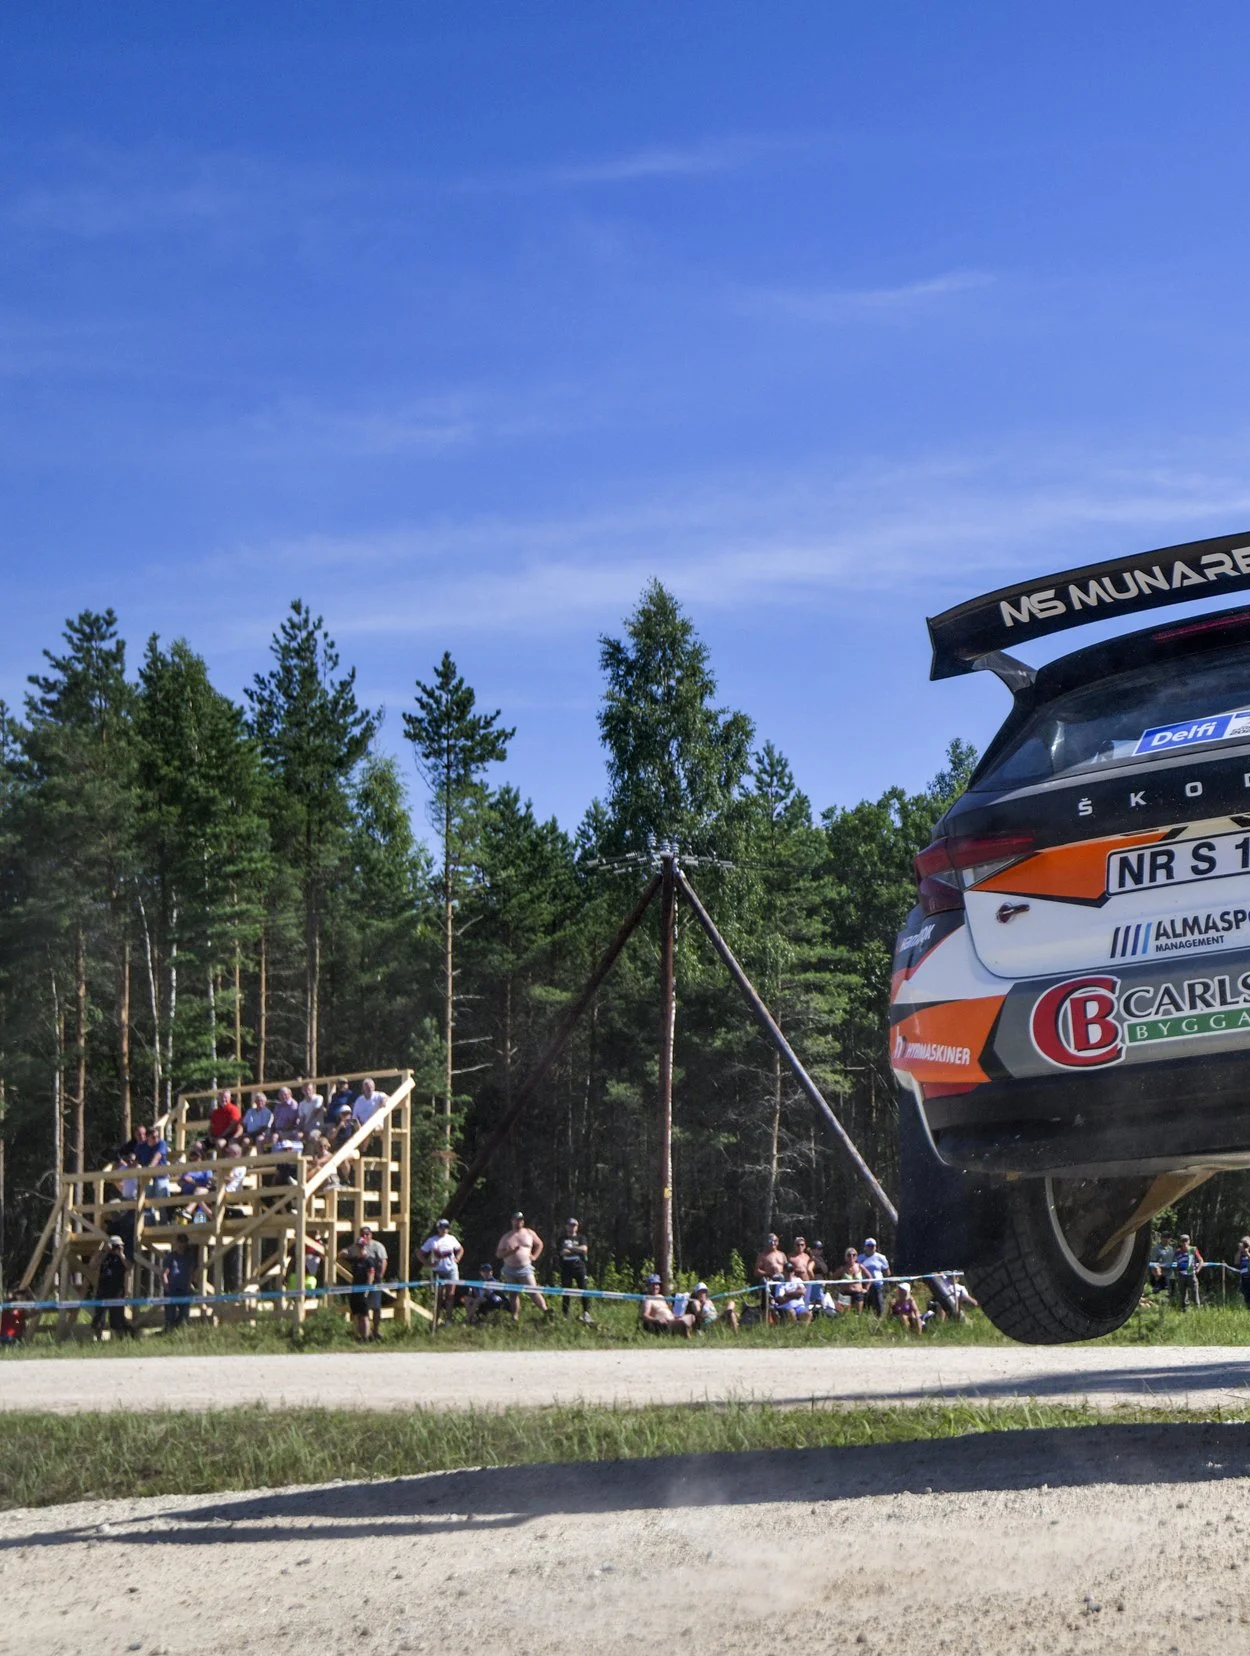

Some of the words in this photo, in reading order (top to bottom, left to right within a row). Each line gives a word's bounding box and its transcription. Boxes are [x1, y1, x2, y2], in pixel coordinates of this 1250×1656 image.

[1000, 589, 1067, 627] MS
[1150, 721, 1218, 747] Delfi
[1118, 848, 1176, 889] NR
[1190, 841, 1218, 876] S
[1155, 935, 1225, 953] MANAGEMENT
